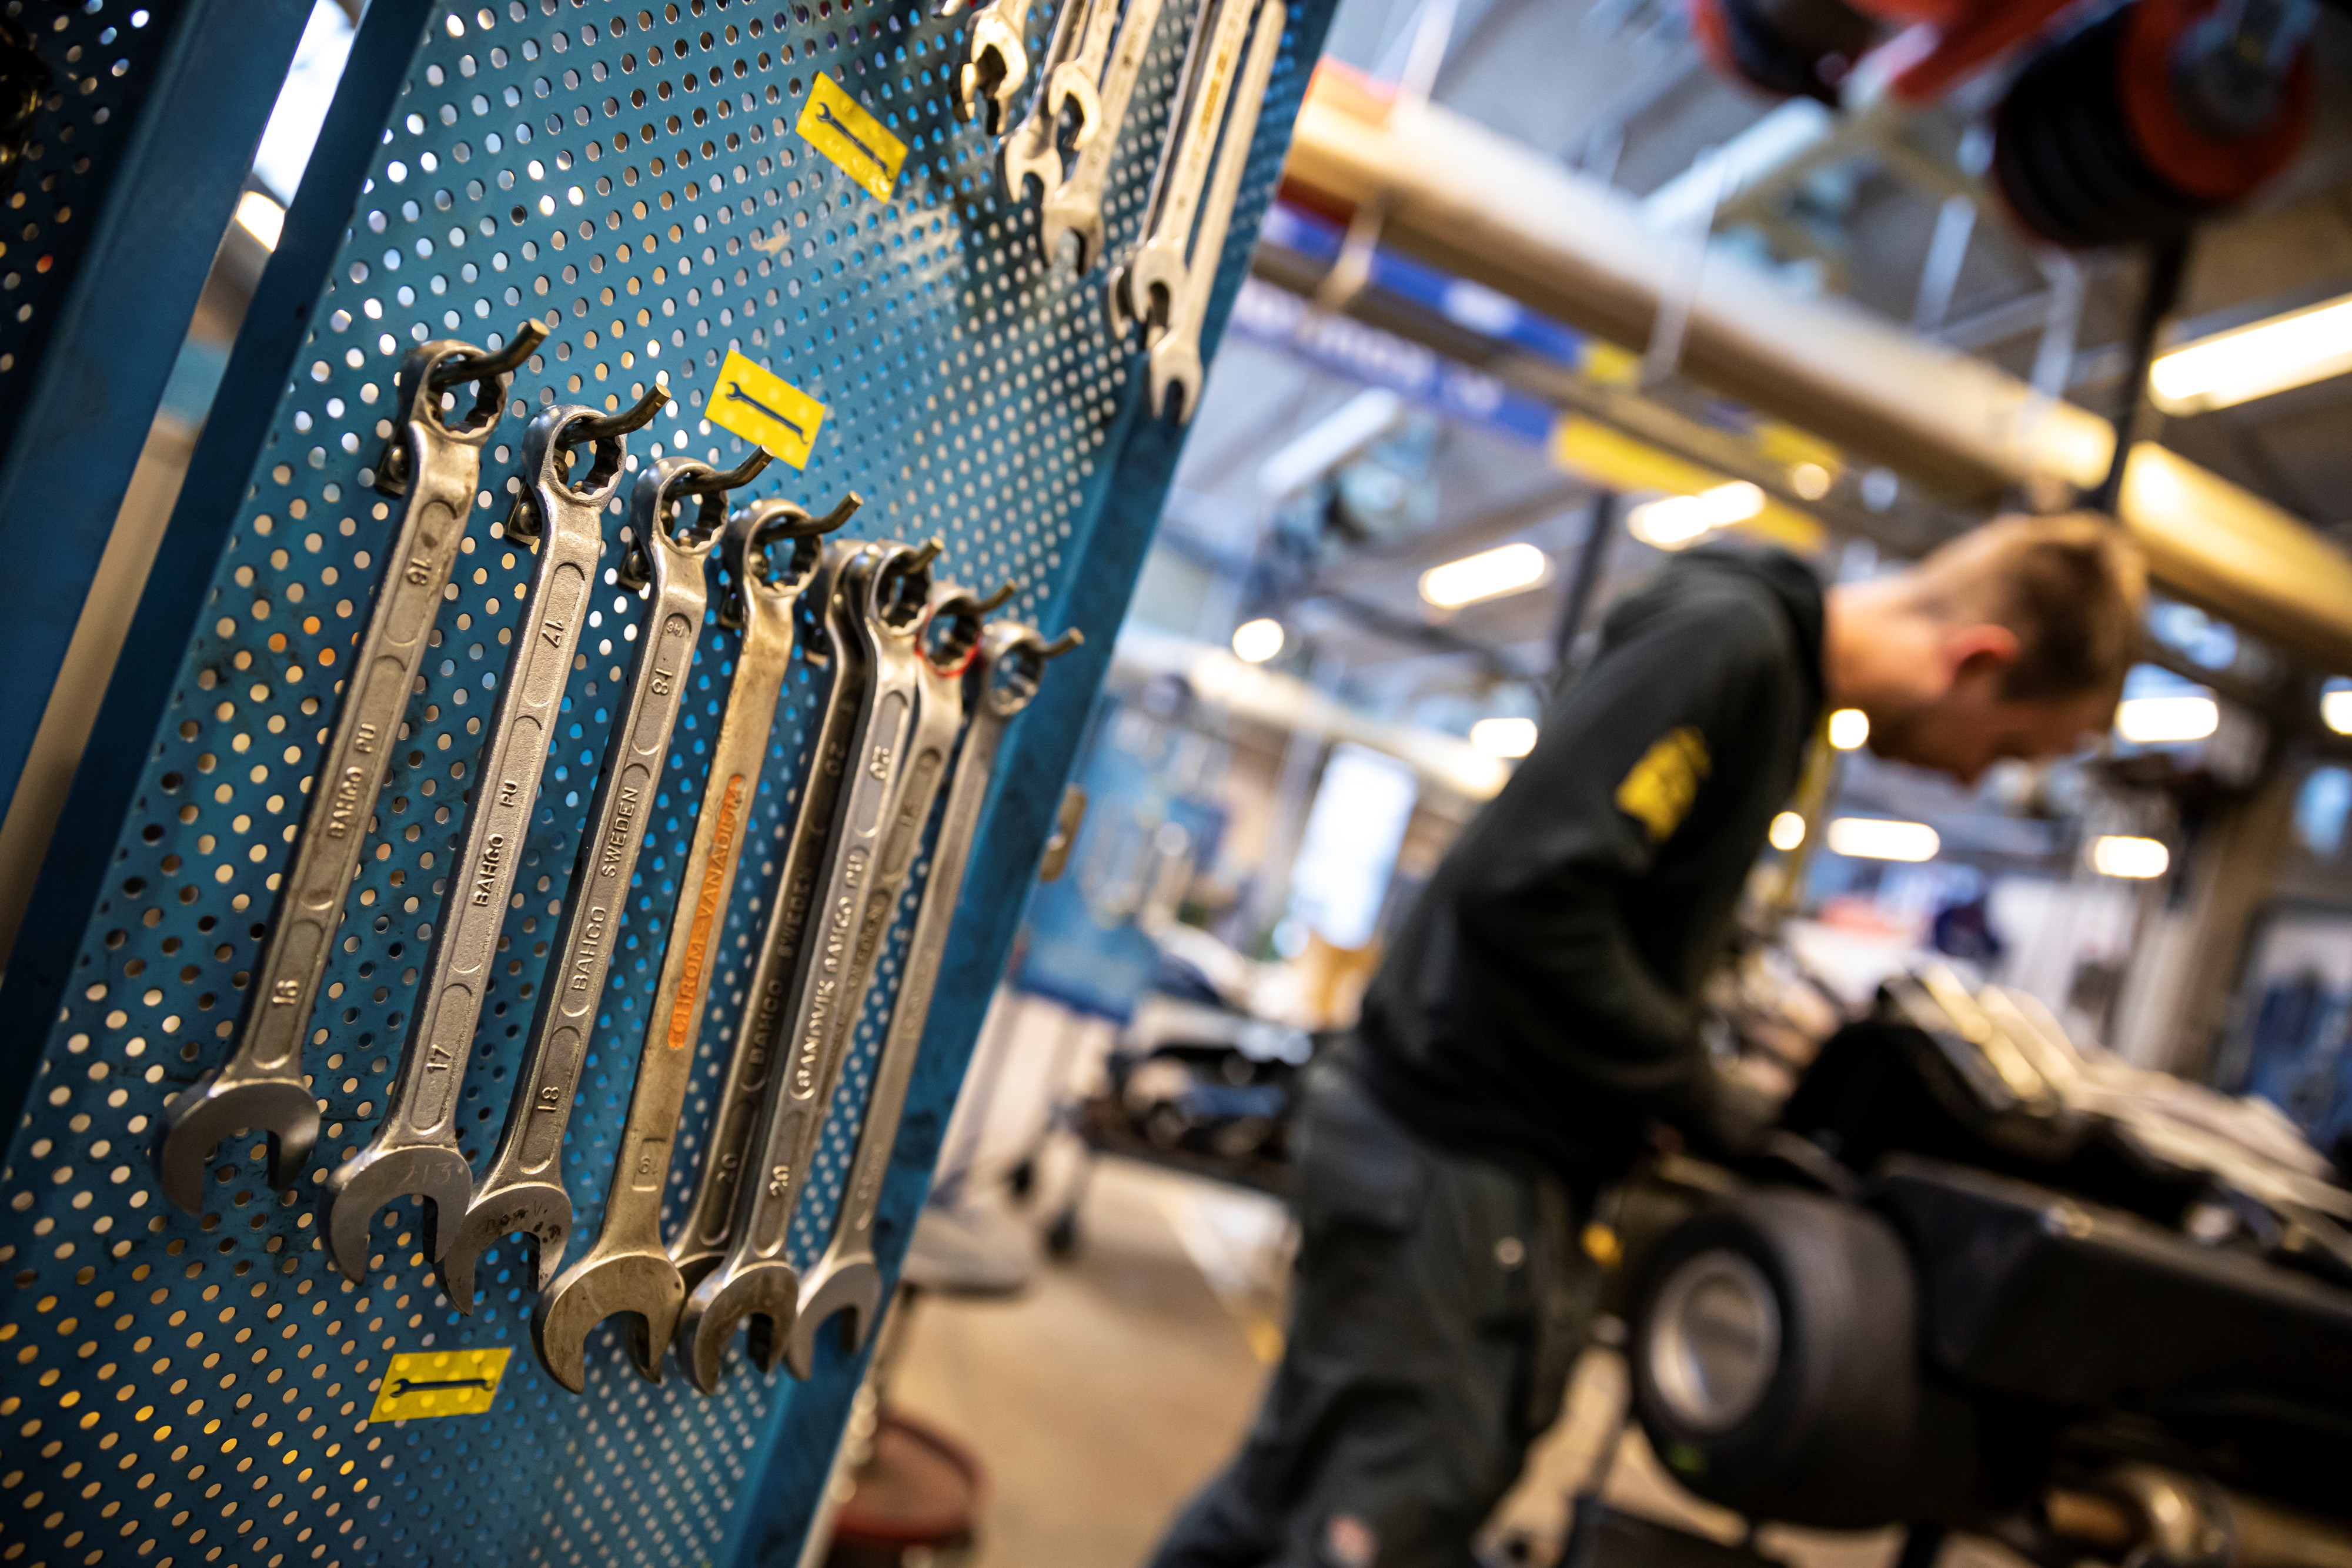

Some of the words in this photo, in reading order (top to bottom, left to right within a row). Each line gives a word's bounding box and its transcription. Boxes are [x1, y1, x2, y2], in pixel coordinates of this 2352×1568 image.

[407, 558, 432, 585] 16
[542, 620, 563, 647] 17
[652, 668, 673, 694] 18
[869, 745, 890, 780] 20
[328, 766, 363, 838] BAHCO
[472, 833, 505, 907] BAHCO
[500, 779, 518, 807] PU
[571, 905, 606, 991] BAHCO
[601, 786, 639, 878] SWEDEN
[749, 979, 783, 1065] BAHCO
[796, 980, 835, 1088] SANDVIK
[426, 1044, 452, 1073] 17
[537, 1086, 560, 1112] 18
[717, 1153, 736, 1183] 20
[769, 1165, 790, 1196] 20
